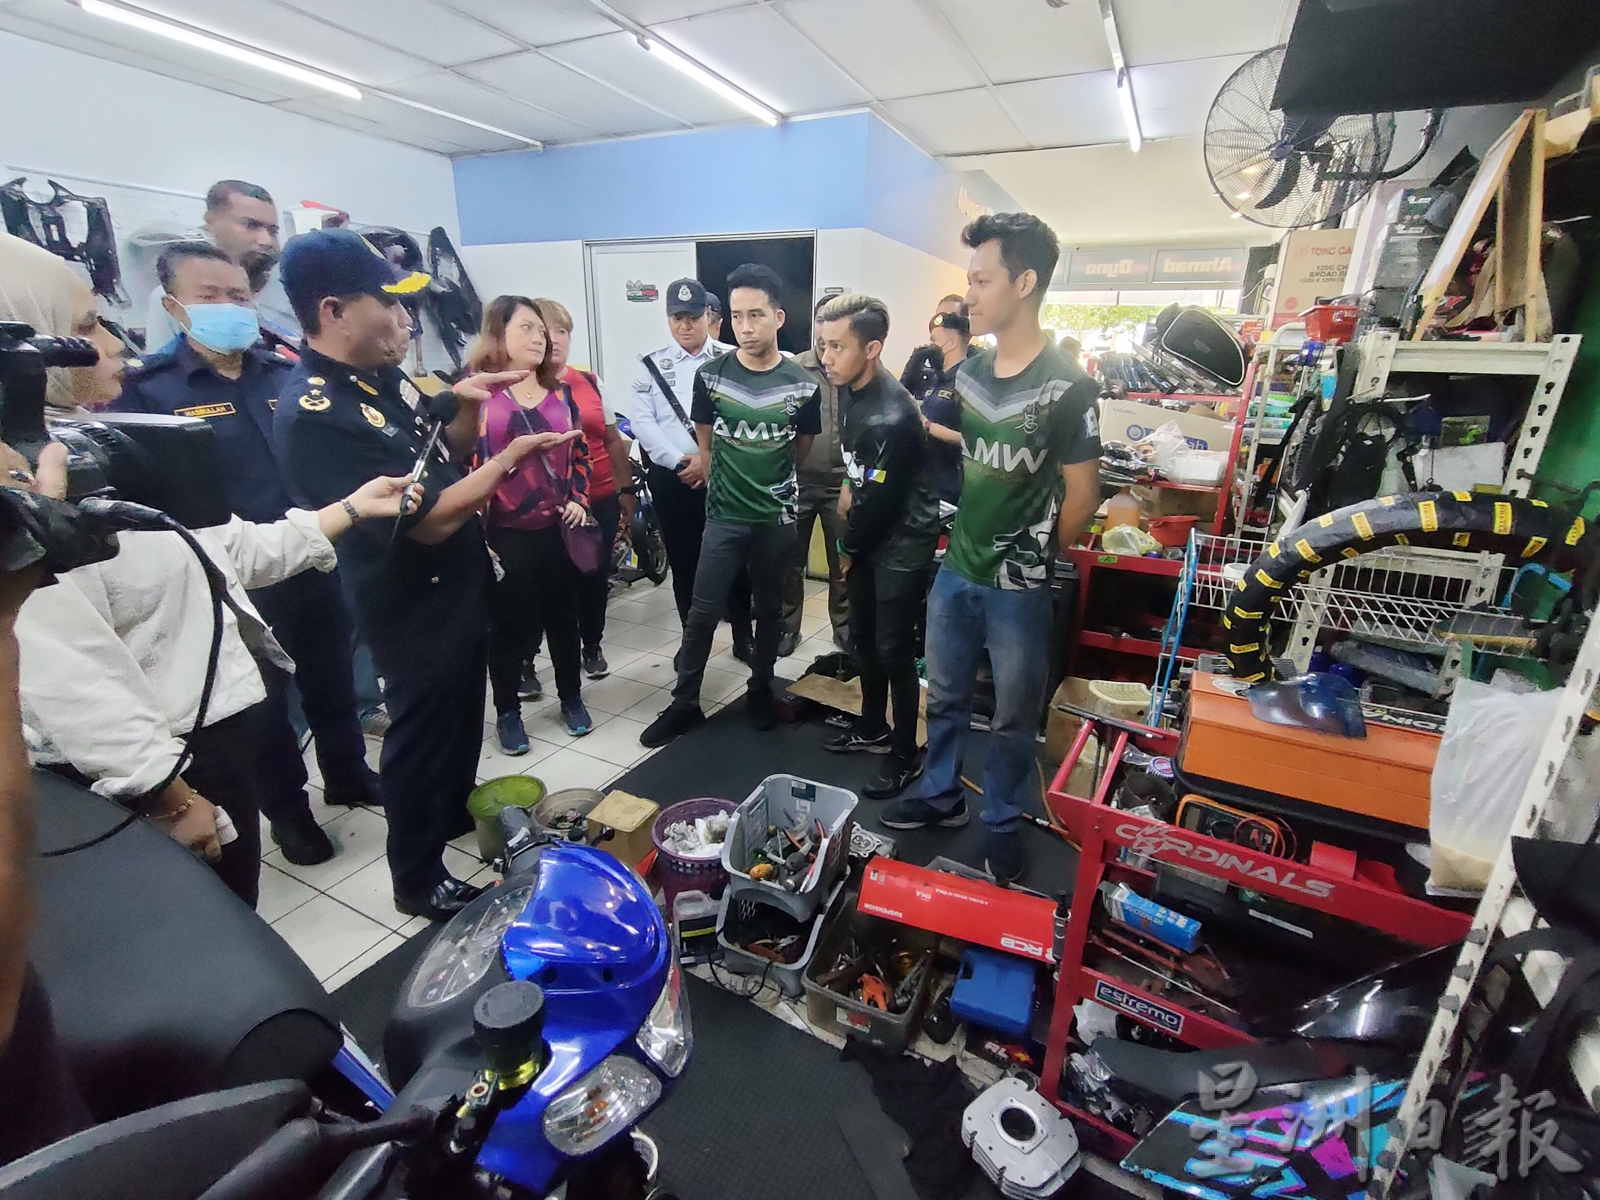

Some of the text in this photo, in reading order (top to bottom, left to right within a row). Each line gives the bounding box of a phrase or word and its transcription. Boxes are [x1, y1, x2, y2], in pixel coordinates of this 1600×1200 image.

[713, 416, 797, 441] AMW
[864, 902, 903, 918] SUSPENSION
[1000, 937, 1043, 957] RCB
[1100, 987, 1178, 1025] estremo
